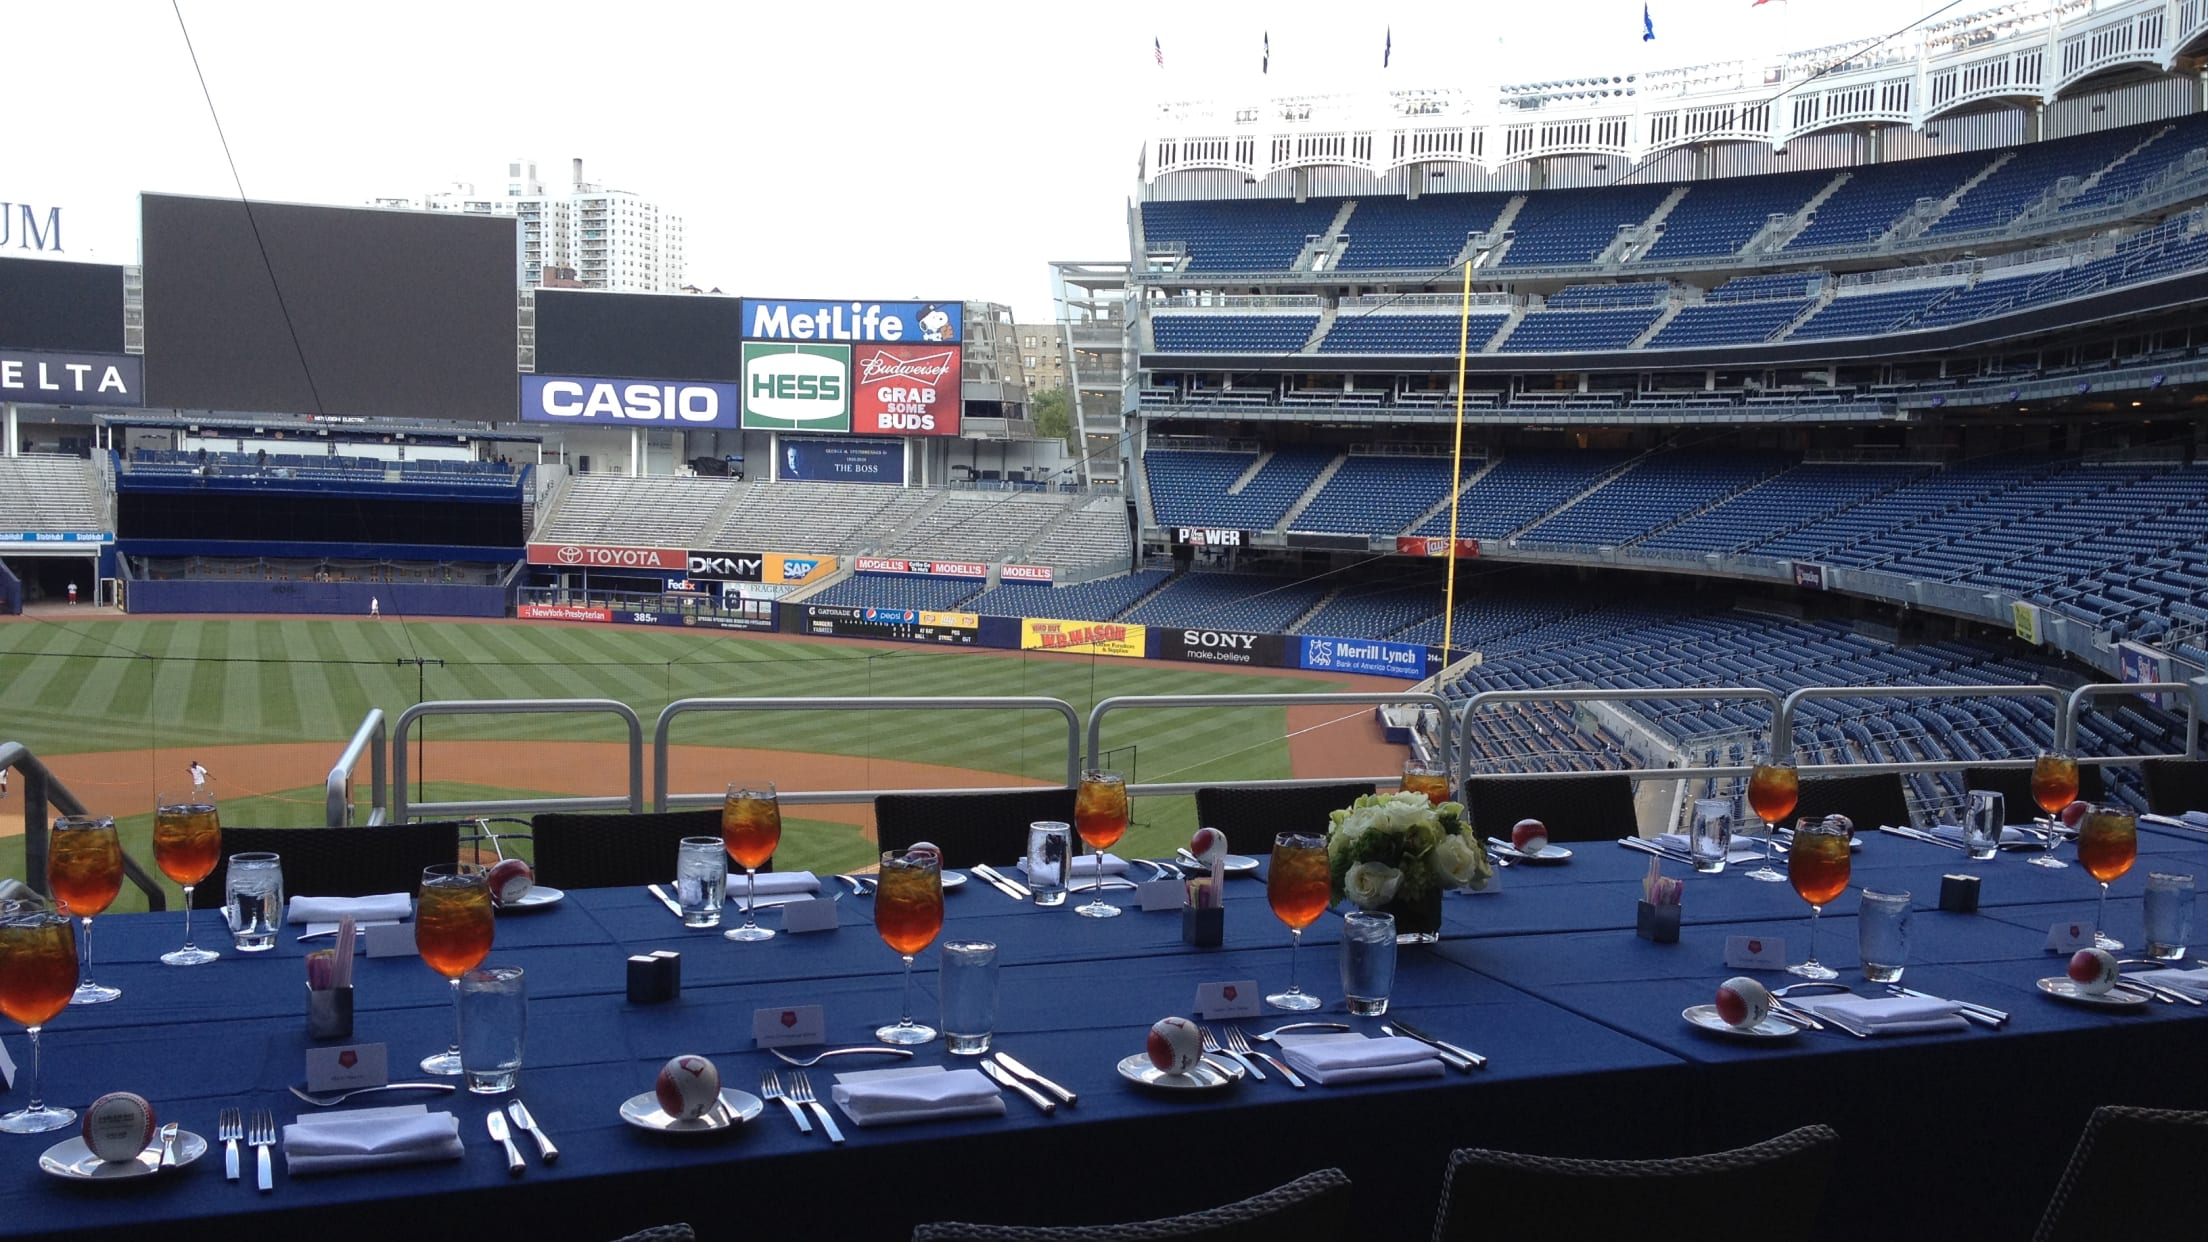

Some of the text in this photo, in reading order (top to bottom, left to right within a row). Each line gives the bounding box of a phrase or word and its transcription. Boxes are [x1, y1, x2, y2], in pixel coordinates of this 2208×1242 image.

[752, 302, 904, 341] MetLife
[860, 358, 950, 376] Budweiser
[1, 360, 128, 393] ELTA
[753, 373, 840, 400] HESS
[541, 380, 719, 421] CASIO
[877, 387, 936, 403] GRAB
[887, 403, 926, 413] SOME
[878, 413, 935, 430] BUDS
[834, 463, 879, 473] THE BOSS
[586, 548, 661, 566] TOYOTA
[689, 552, 763, 576] DKNY
[859, 559, 904, 570] MODELL'S
[784, 561, 811, 577] SAP
[935, 563, 982, 574] MODELL'S
[1003, 566, 1051, 578] MODELL'S
[667, 579, 696, 591] FedEx
[808, 606, 816, 615] G
[817, 608, 851, 616] GATORADE
[853, 609, 861, 619] G
[879, 611, 901, 621] pepsi
[1184, 630, 1258, 649] SONY
[1187, 649, 1251, 663] make.believe
[1336, 642, 1416, 664] Merrill Lynch
[1336, 659, 1352, 668] Bank
[1360, 662, 1385, 672] America
[1386, 664, 1420, 675] Corporation
